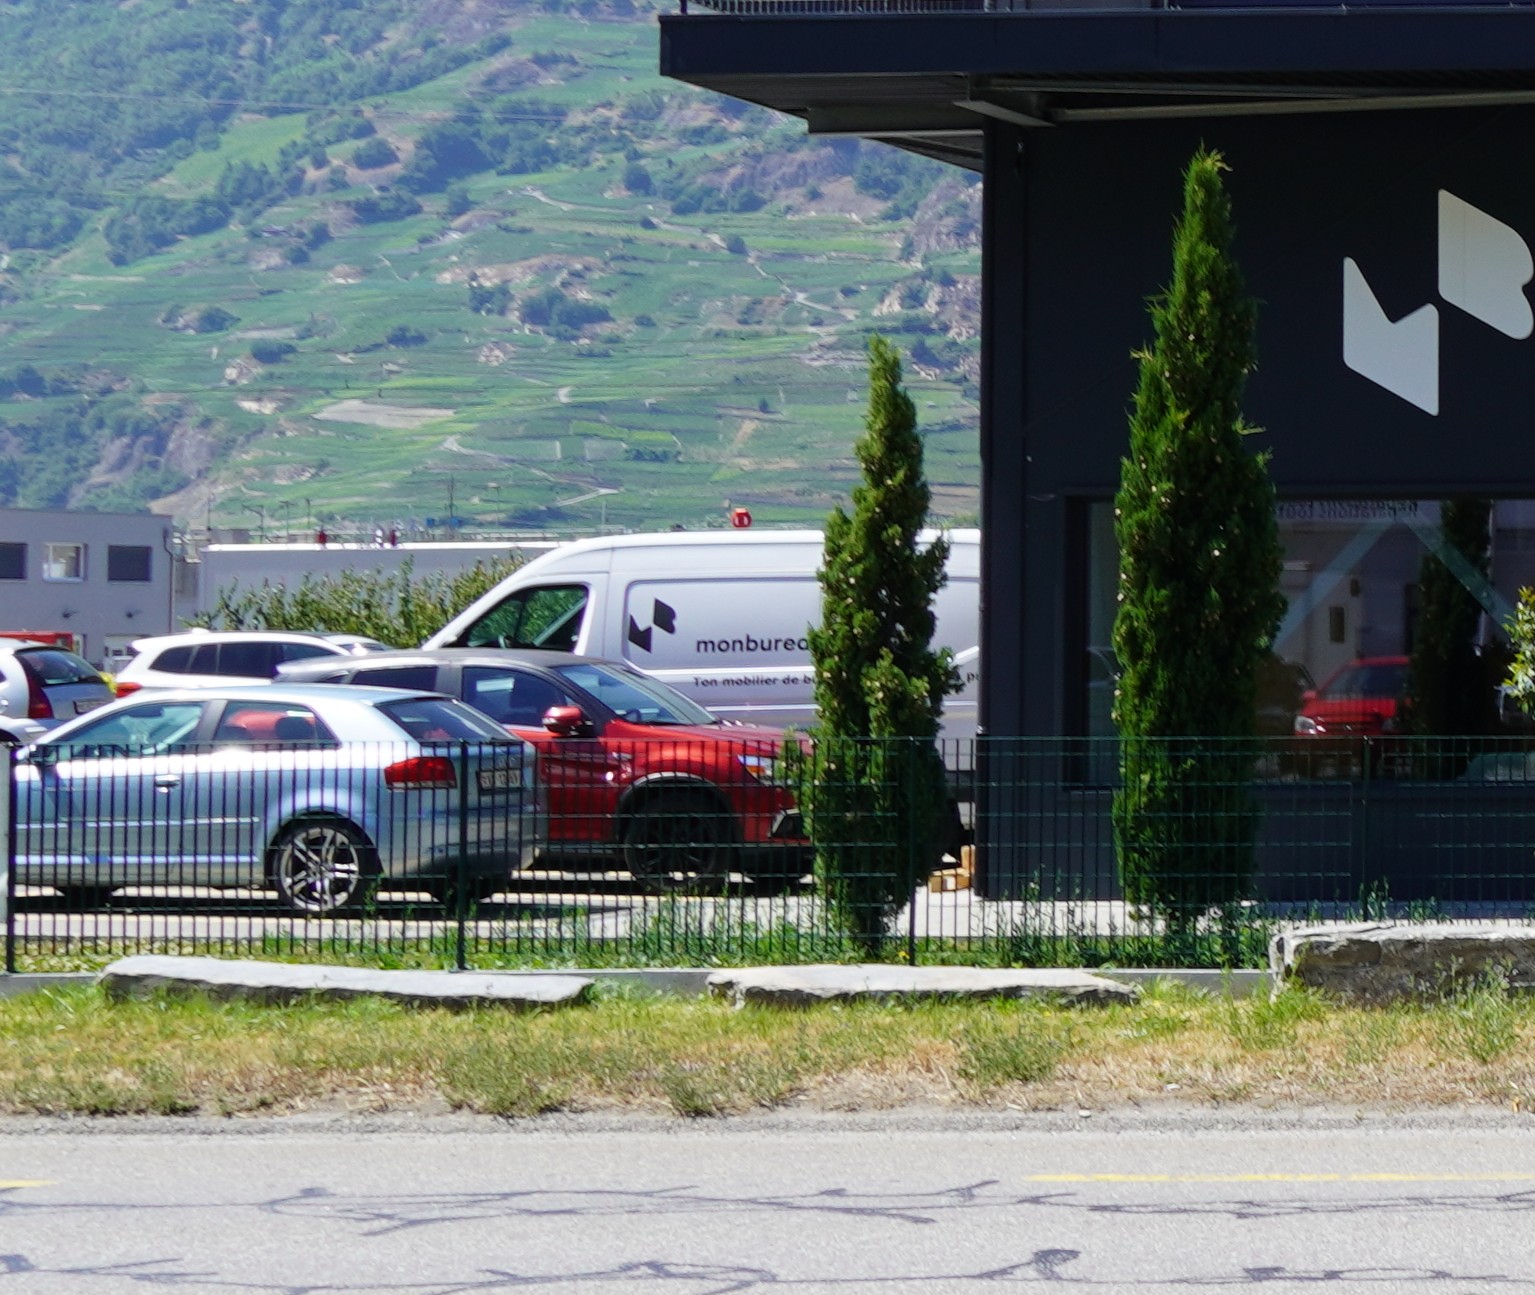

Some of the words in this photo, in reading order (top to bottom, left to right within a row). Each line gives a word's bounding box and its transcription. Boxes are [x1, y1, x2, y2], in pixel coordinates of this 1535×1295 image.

[695, 633, 810, 654] monburea
[693, 677, 718, 688] Ton
[722, 675, 778, 687] mobilier
[782, 675, 800, 685] de
